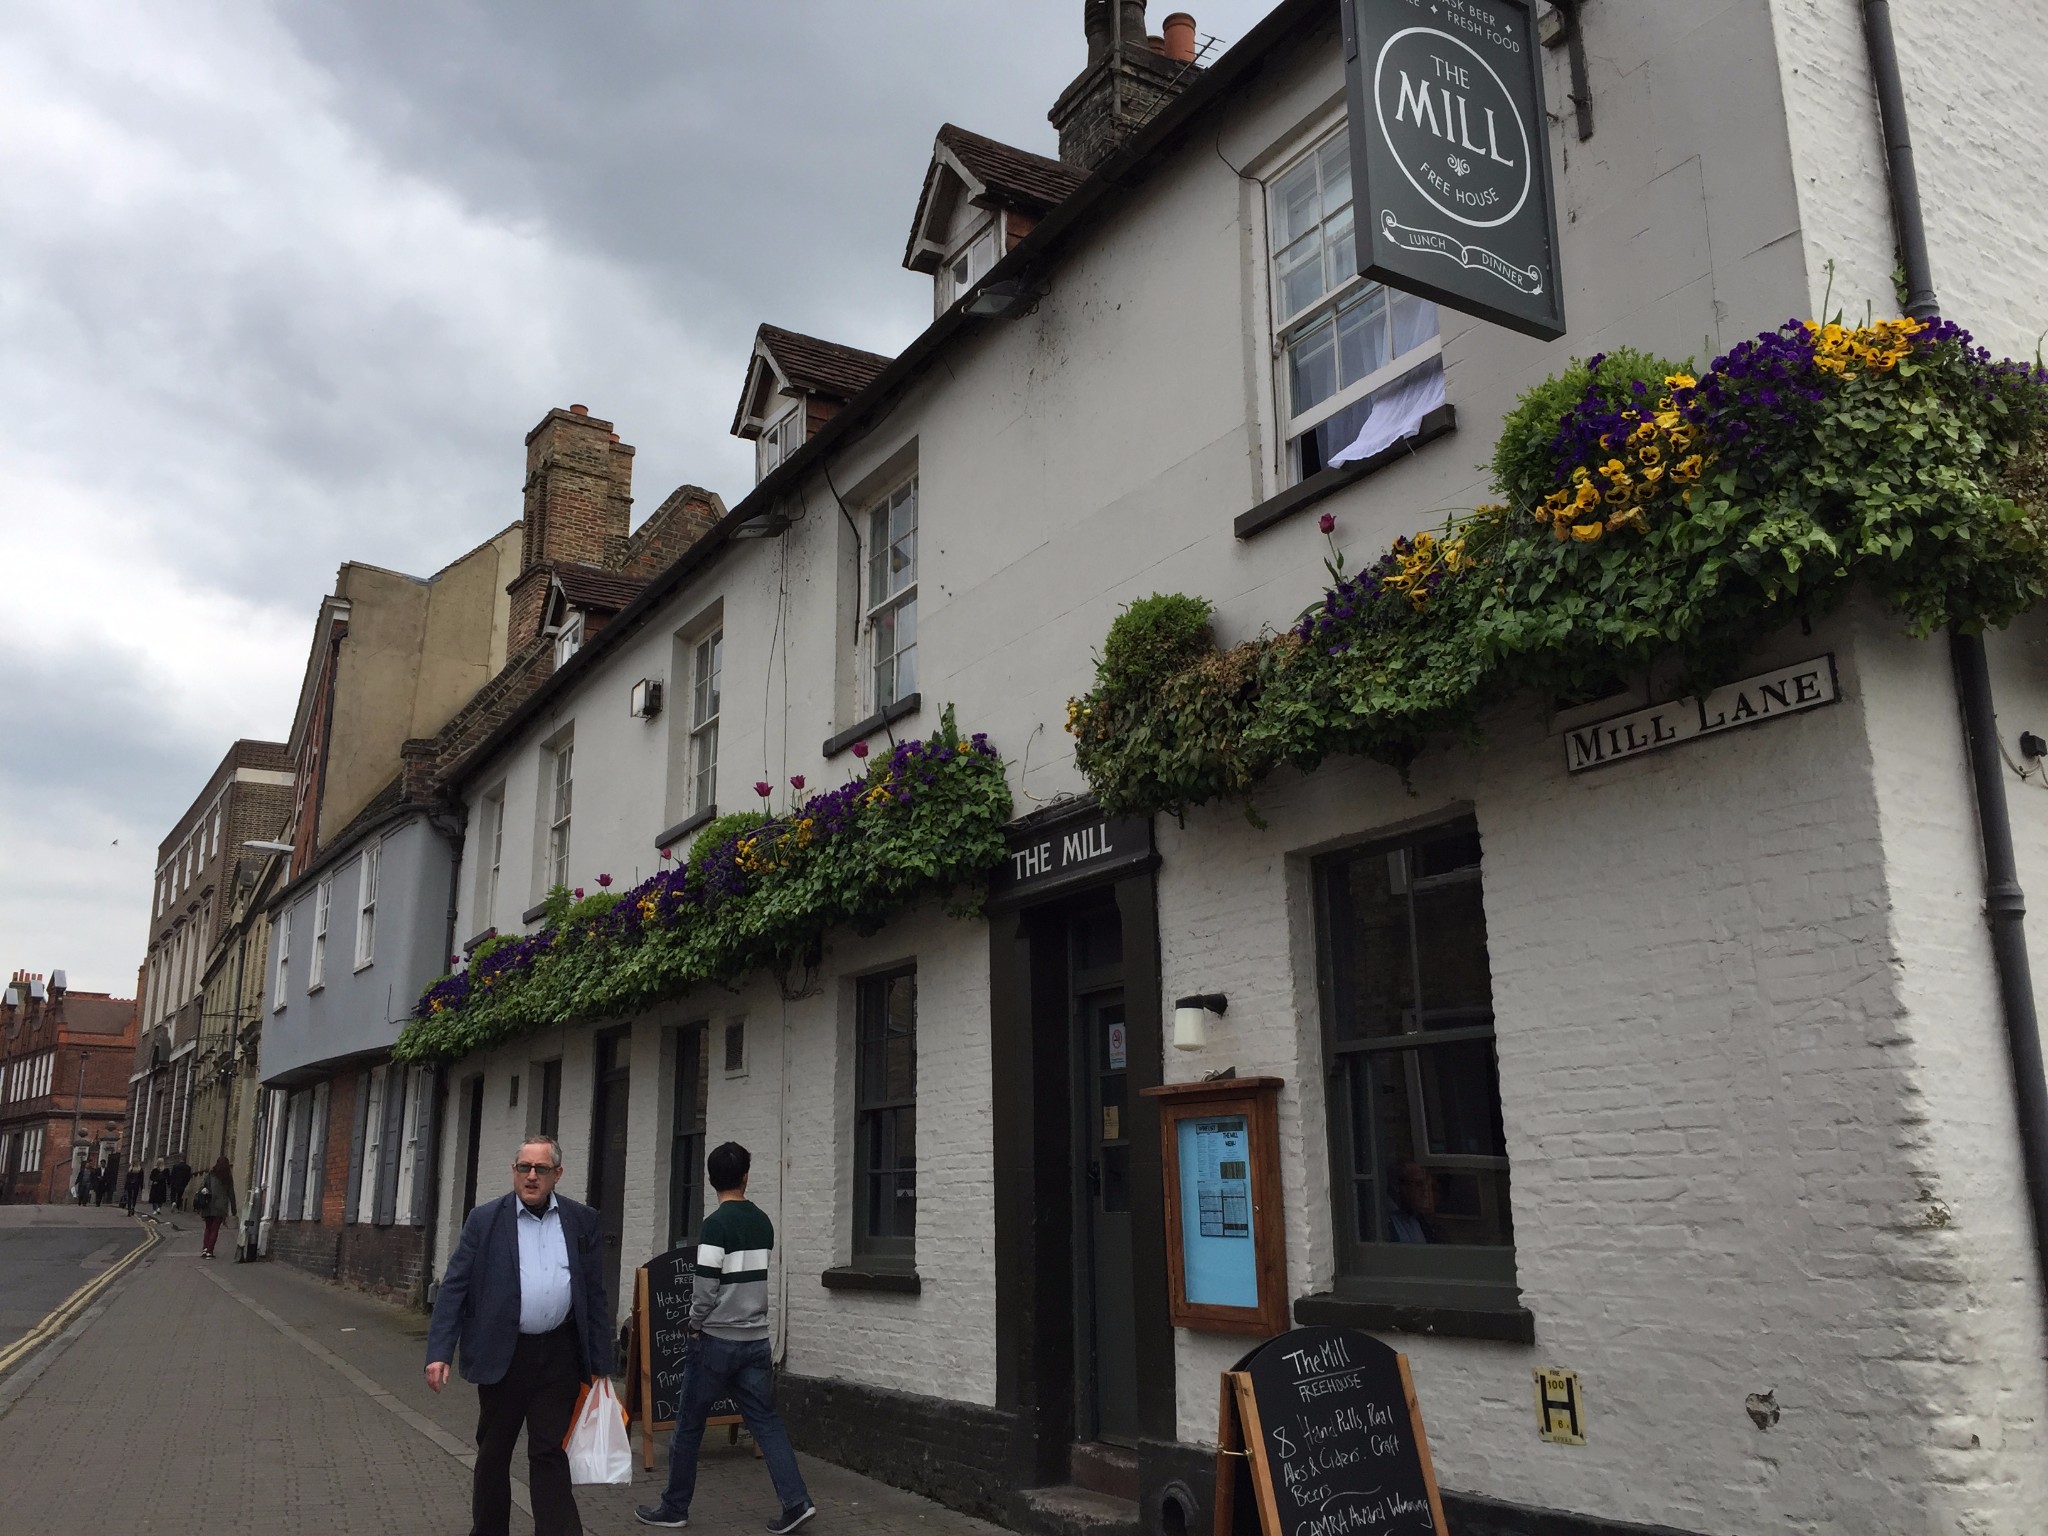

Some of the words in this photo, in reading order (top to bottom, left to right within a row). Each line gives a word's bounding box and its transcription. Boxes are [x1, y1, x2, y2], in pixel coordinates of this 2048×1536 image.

[1447, 10, 1482, 36] FRESH
[1486, 29, 1520, 53] FOOD
[1469, 5, 1496, 27] BEER
[1429, 54, 1470, 90] THE
[1395, 70, 1513, 168] MILL
[1420, 162, 1450, 196] FREE
[1455, 187, 1499, 207] HOUSE
[1408, 233, 1446, 250] LUNCH
[1481, 253, 1523, 286] DINNER
[1572, 715, 1676, 767] MILL
[1699, 672, 1822, 731] LANE
[1011, 841, 1052, 880] THE
[1061, 823, 1113, 866] MILL
[670, 1257, 696, 1273] The
[656, 1291, 674, 1308] Hot
[666, 1308, 679, 1320] to
[1281, 1349, 1325, 1375] The
[1319, 1337, 1350, 1367] Mill
[1547, 1380, 1564, 1390] 100
[1540, 1375, 1578, 1436] H
[1272, 1426, 1297, 1459] 8
[1366, 1402, 1394, 1427] Real
[1283, 1461, 1308, 1487] Ales
[1308, 1456, 1321, 1477] &
[1291, 1484, 1332, 1507] Beers
[1295, 1508, 1349, 1536] CAMRA
[1349, 1501, 1386, 1527] Award
